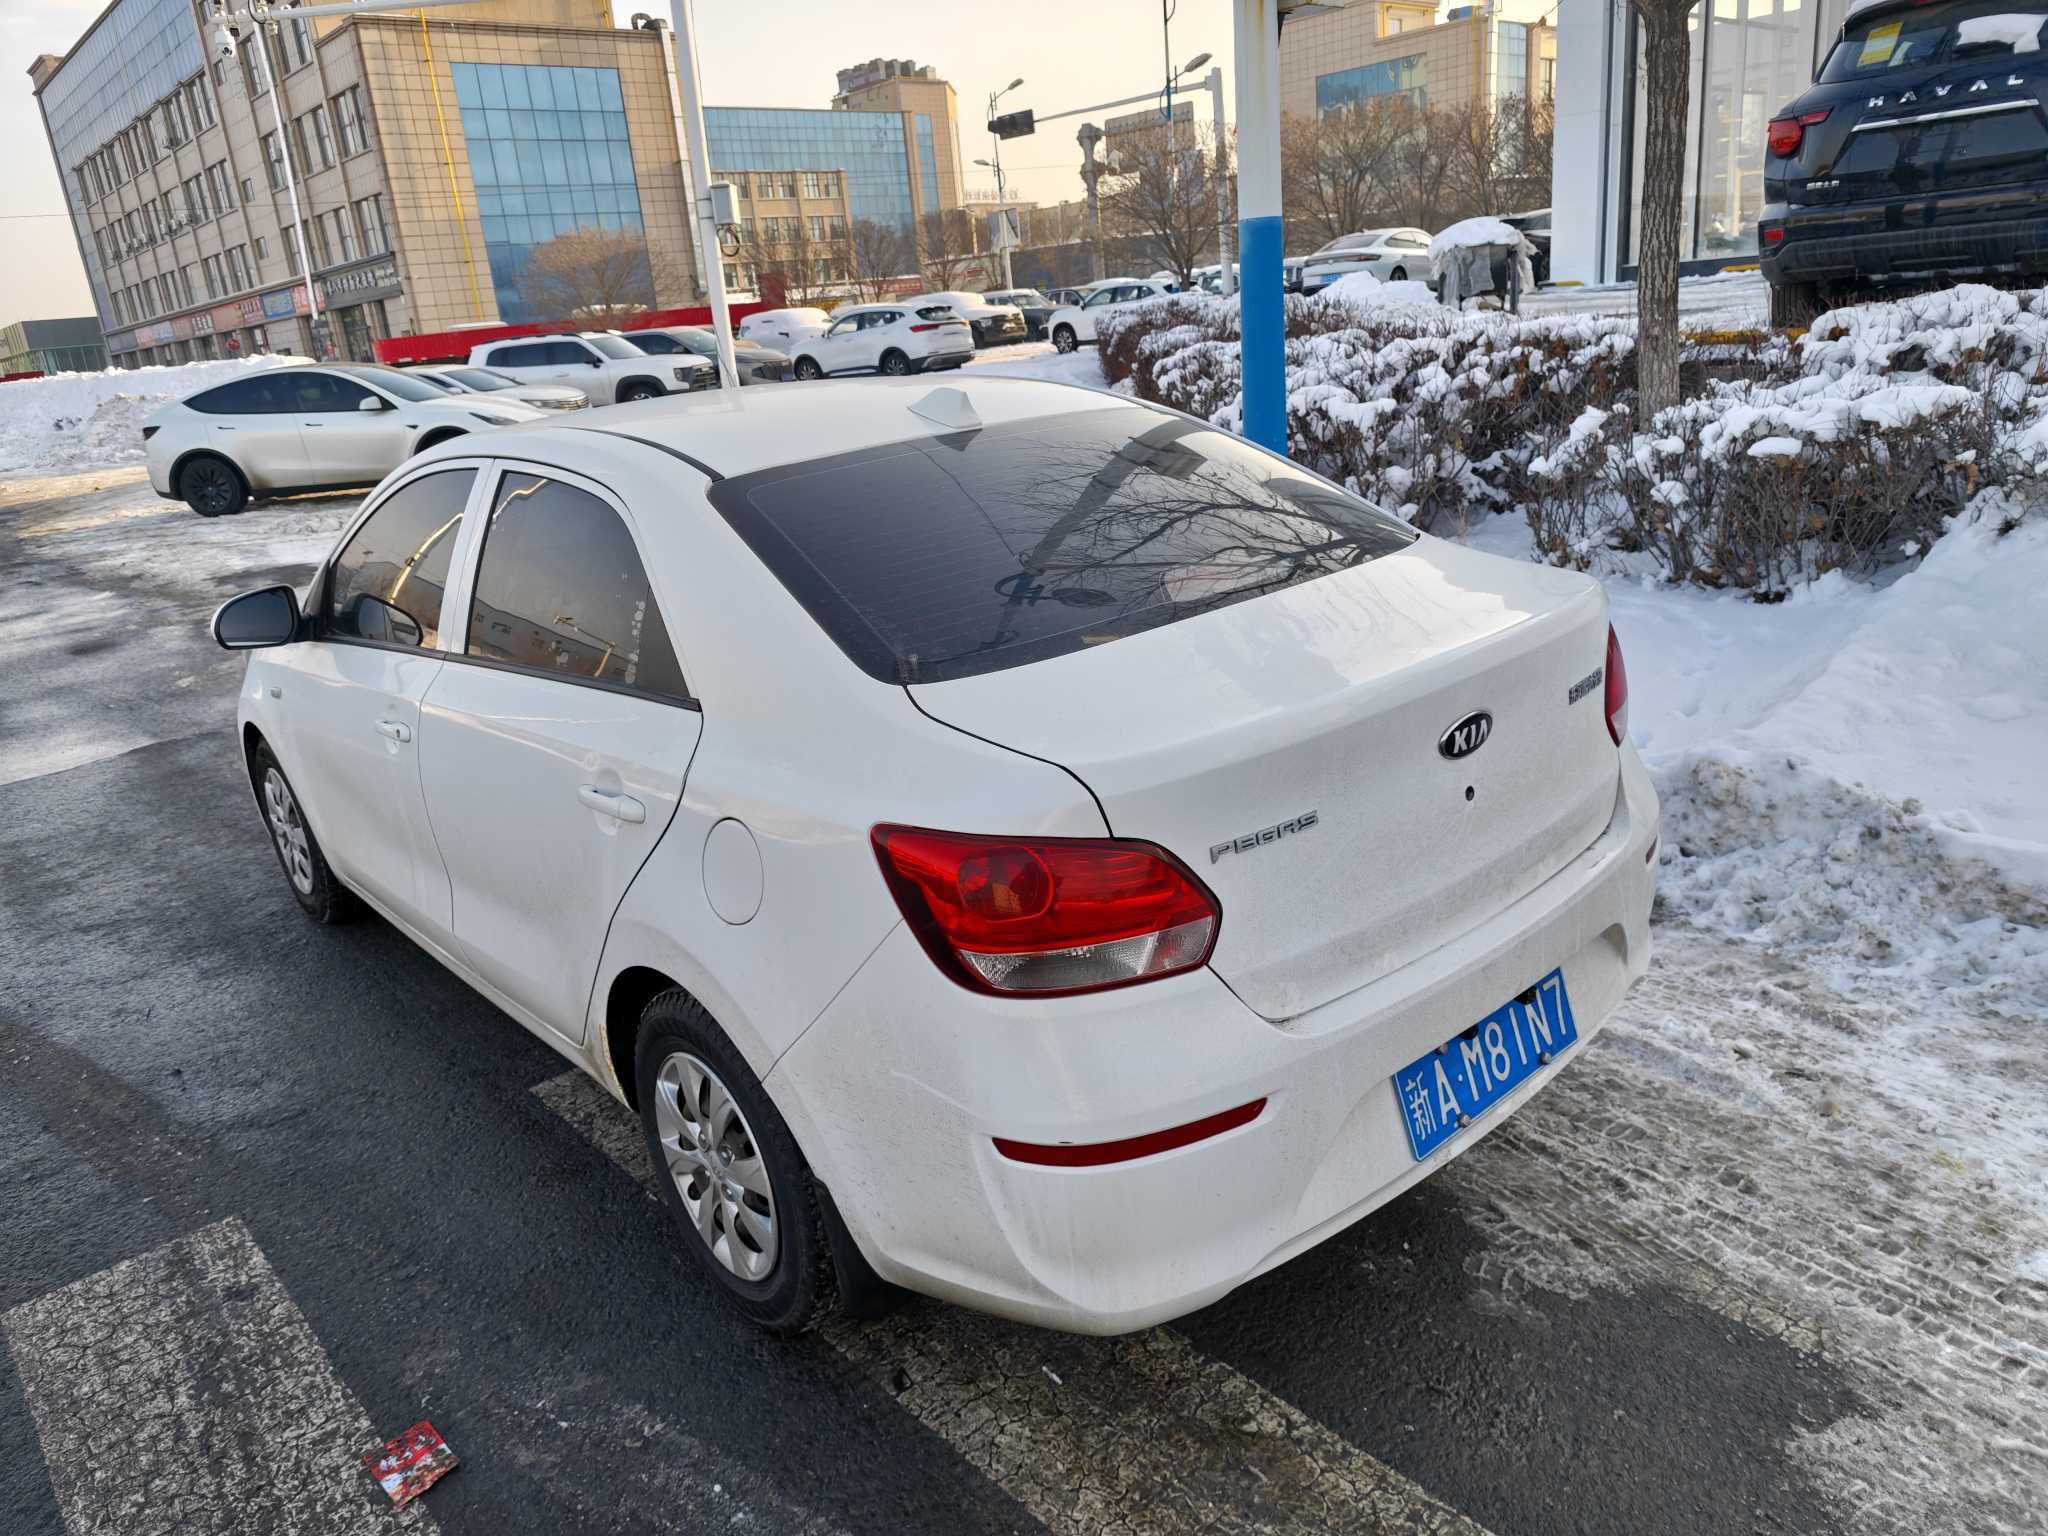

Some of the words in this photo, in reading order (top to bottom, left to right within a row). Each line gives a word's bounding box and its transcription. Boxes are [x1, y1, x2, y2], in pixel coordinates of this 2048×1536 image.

[1868, 74, 2024, 108] HAVAL
[1450, 715, 1490, 756] KIA
[1209, 809, 1319, 864] PEGAS
